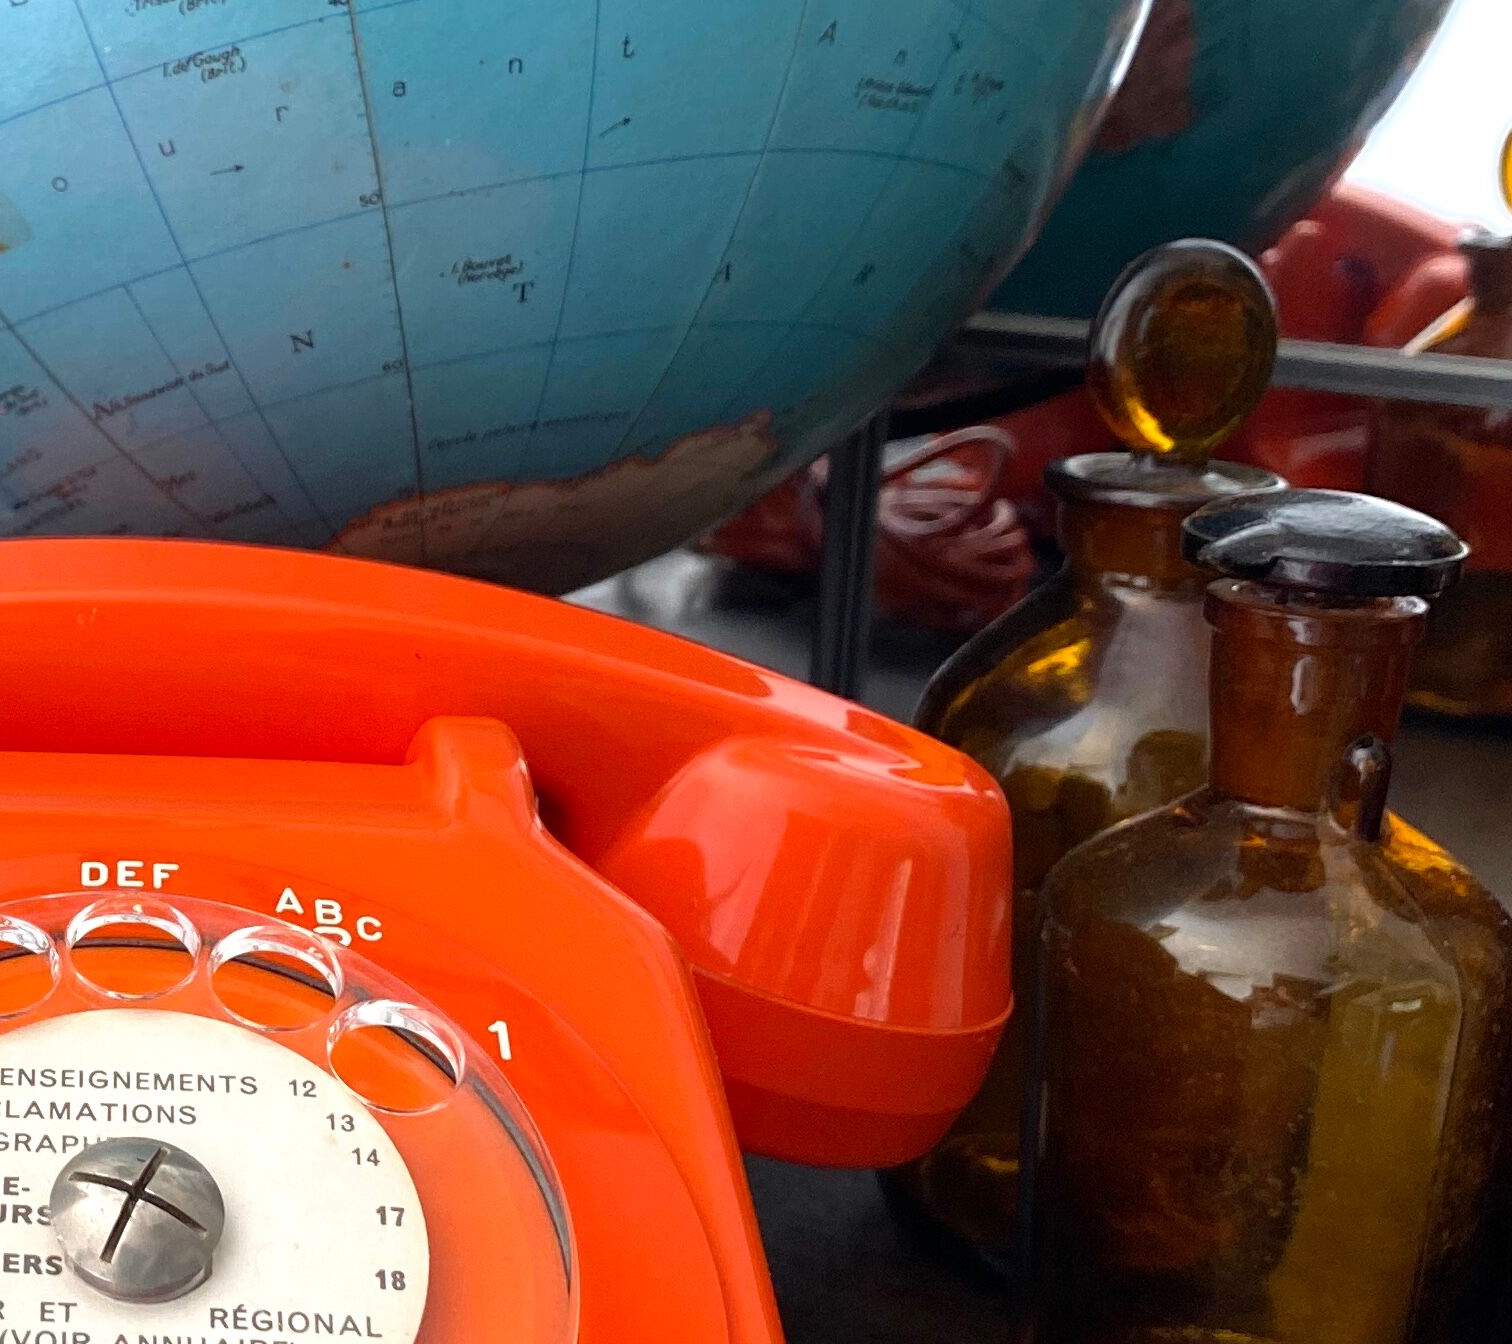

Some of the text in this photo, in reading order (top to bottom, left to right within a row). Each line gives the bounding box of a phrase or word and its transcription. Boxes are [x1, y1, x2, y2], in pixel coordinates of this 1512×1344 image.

[80, 860, 180, 888] DEF
[275, 886, 383, 942] ABC
[486, 1020, 513, 1061] 1
[288, 1079, 317, 1098] 12
[326, 1113, 355, 1132] 13
[351, 1147, 380, 1167] 14
[375, 1206, 405, 1227] 17
[375, 1269, 406, 1291] 18
[39, 1301, 78, 1324] ET
[209, 1305, 384, 1339] RÉGIONAL
